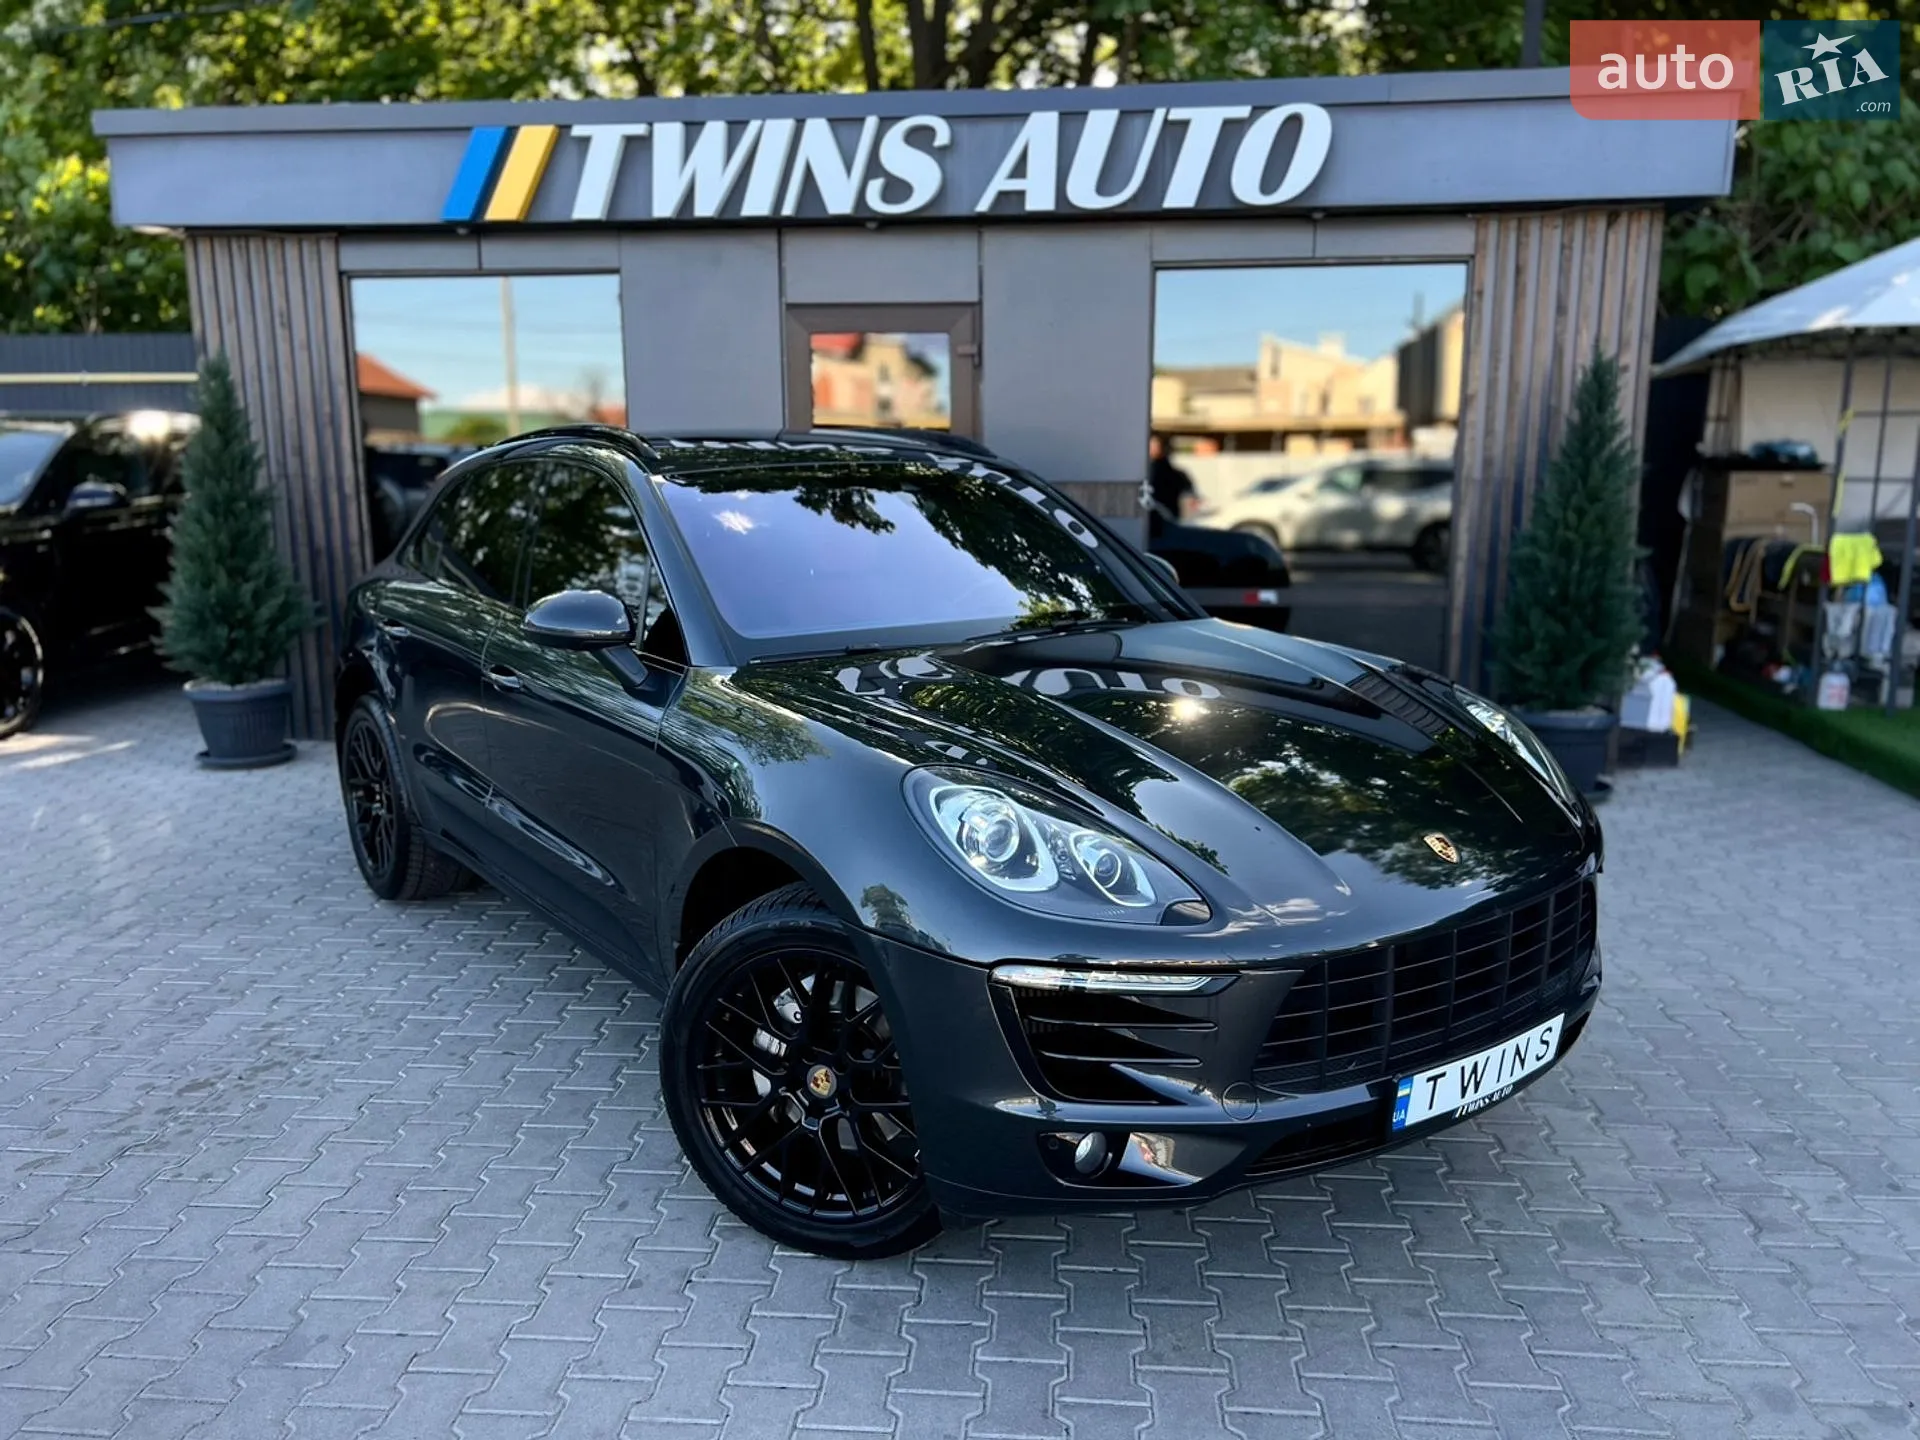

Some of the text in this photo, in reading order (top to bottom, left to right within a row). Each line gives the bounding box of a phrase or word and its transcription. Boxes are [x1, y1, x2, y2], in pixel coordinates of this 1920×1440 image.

[570, 103, 1332, 221] TWINS AUTO
[1426, 1026, 1552, 1110] TWINS
[1392, 1109, 1405, 1122] UA
